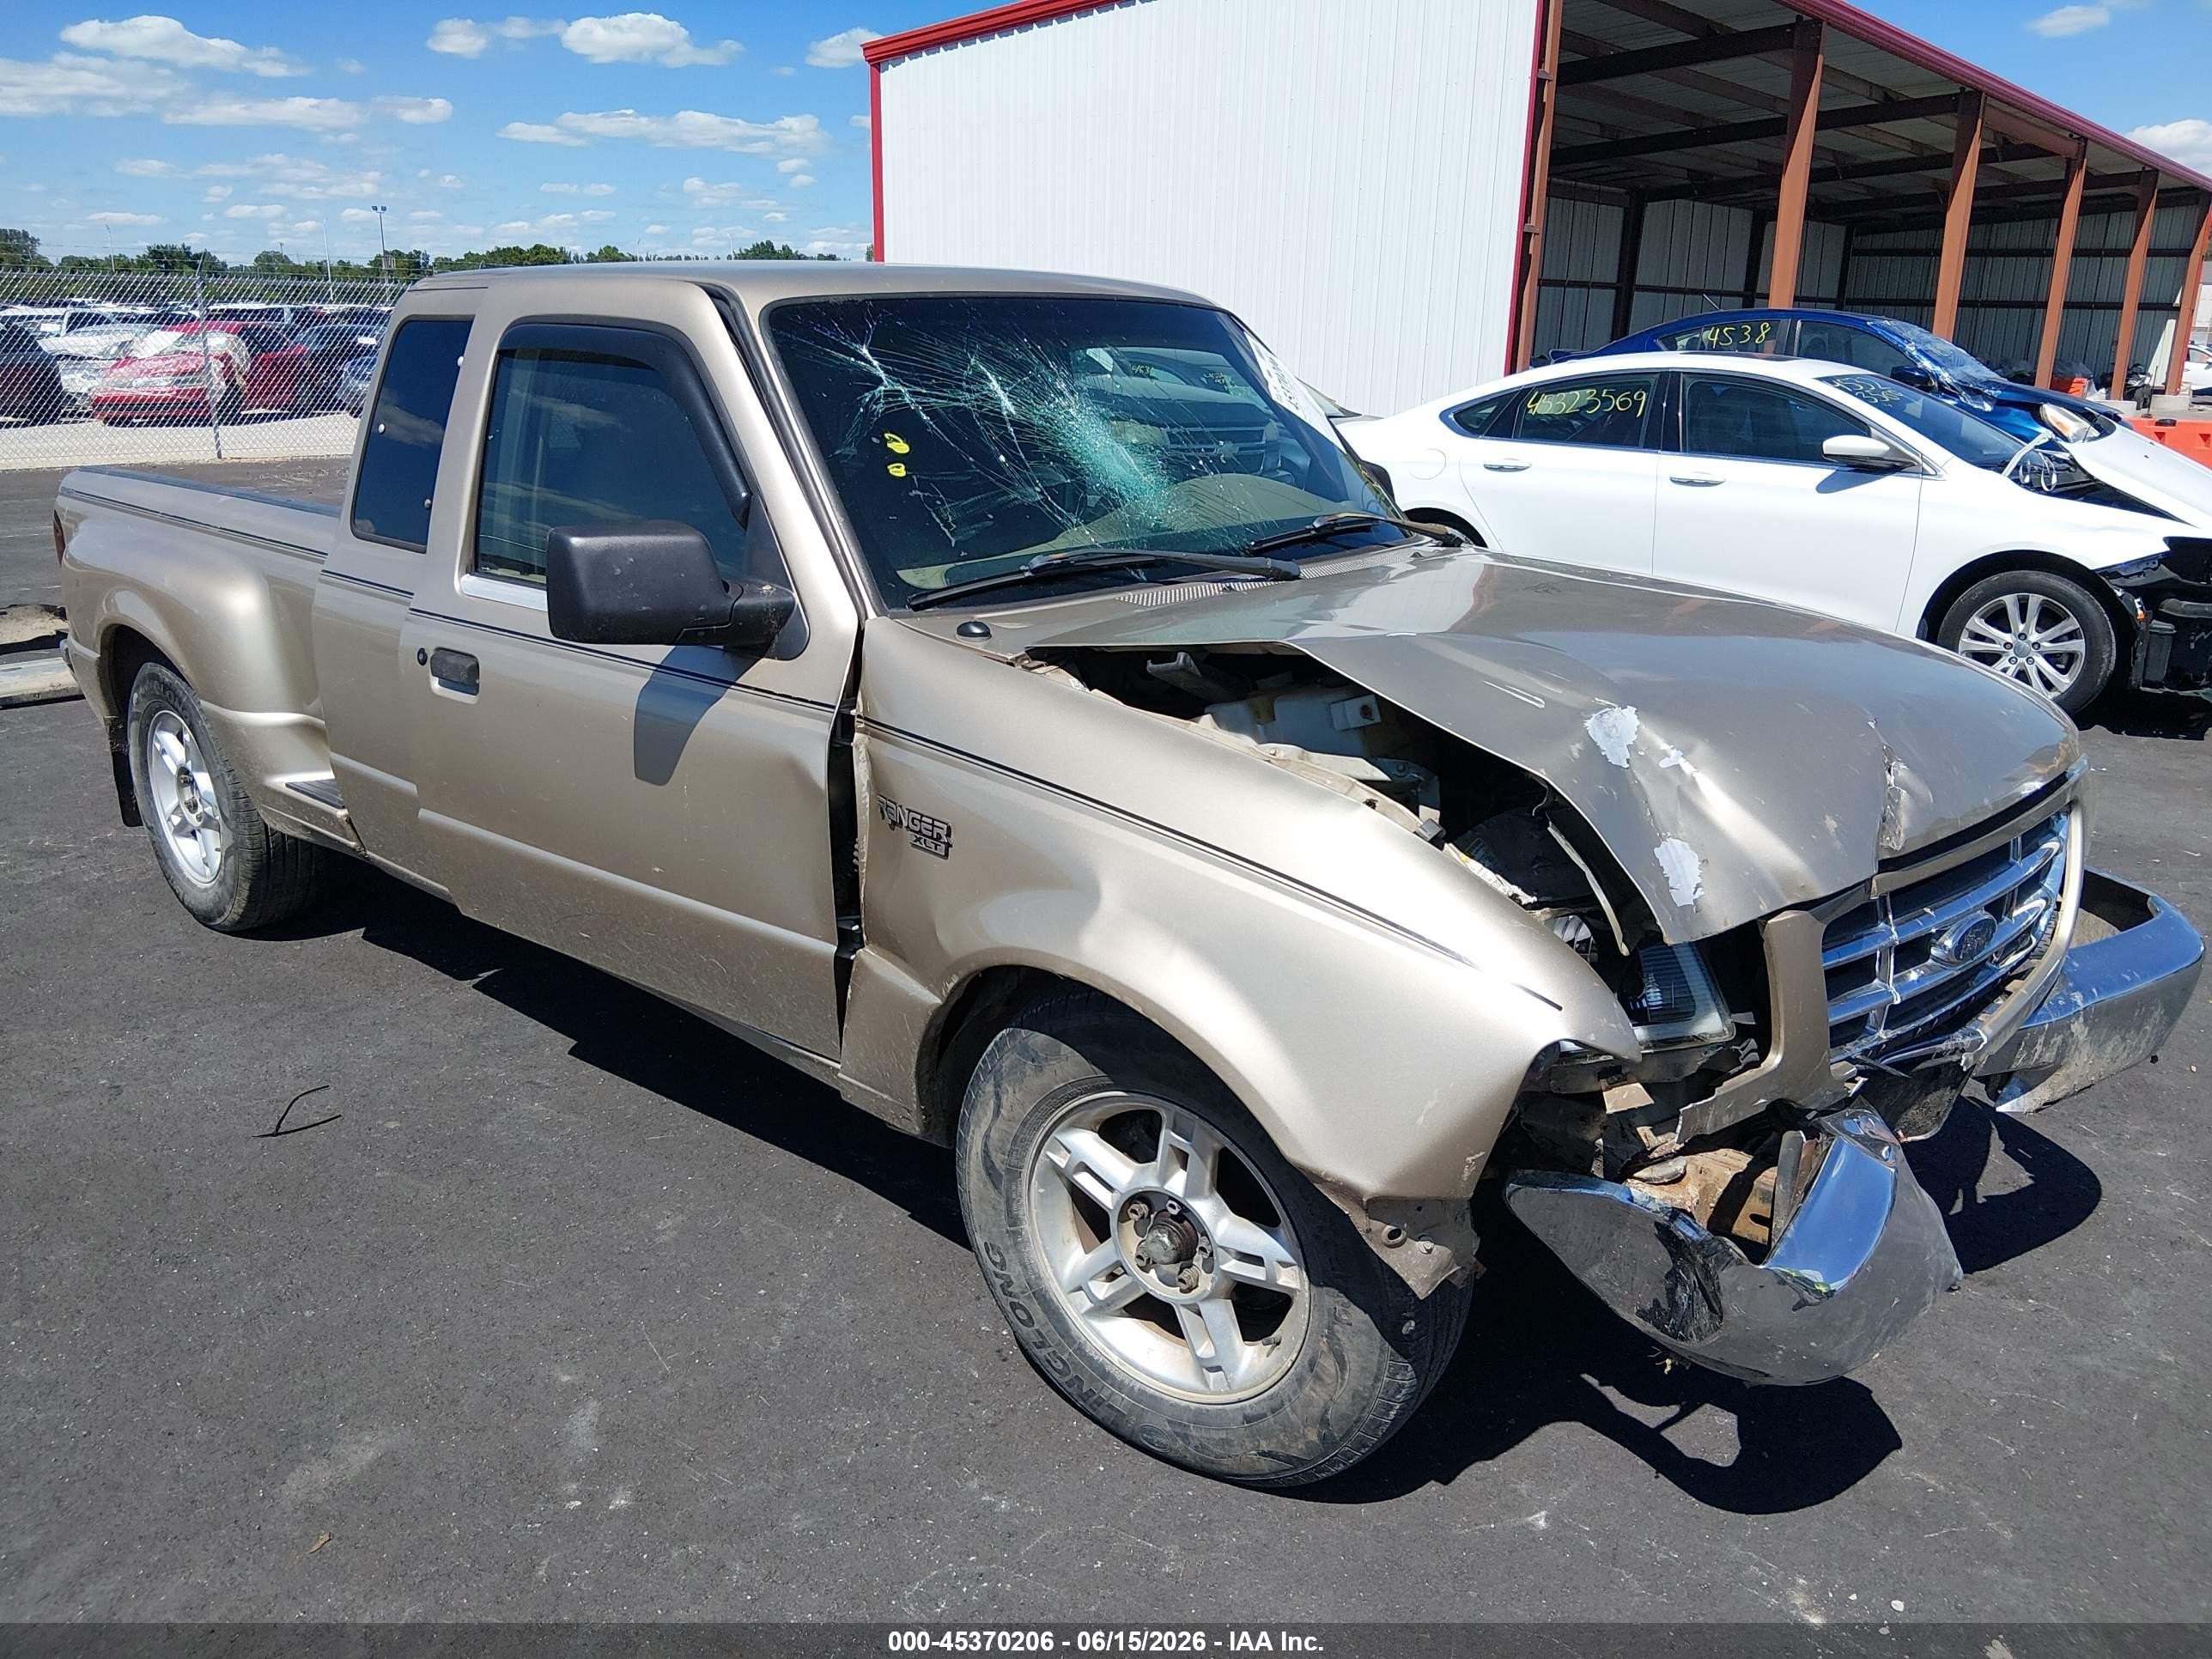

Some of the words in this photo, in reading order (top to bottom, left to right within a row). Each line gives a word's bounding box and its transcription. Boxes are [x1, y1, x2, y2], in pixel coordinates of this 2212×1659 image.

[1707, 322, 1771, 349] 4538
[1527, 388, 1647, 418] 45323569
[878, 793, 953, 844] RANGER
[913, 835, 941, 852] XLT
[984, 1242, 1127, 1425] LINGLONG
